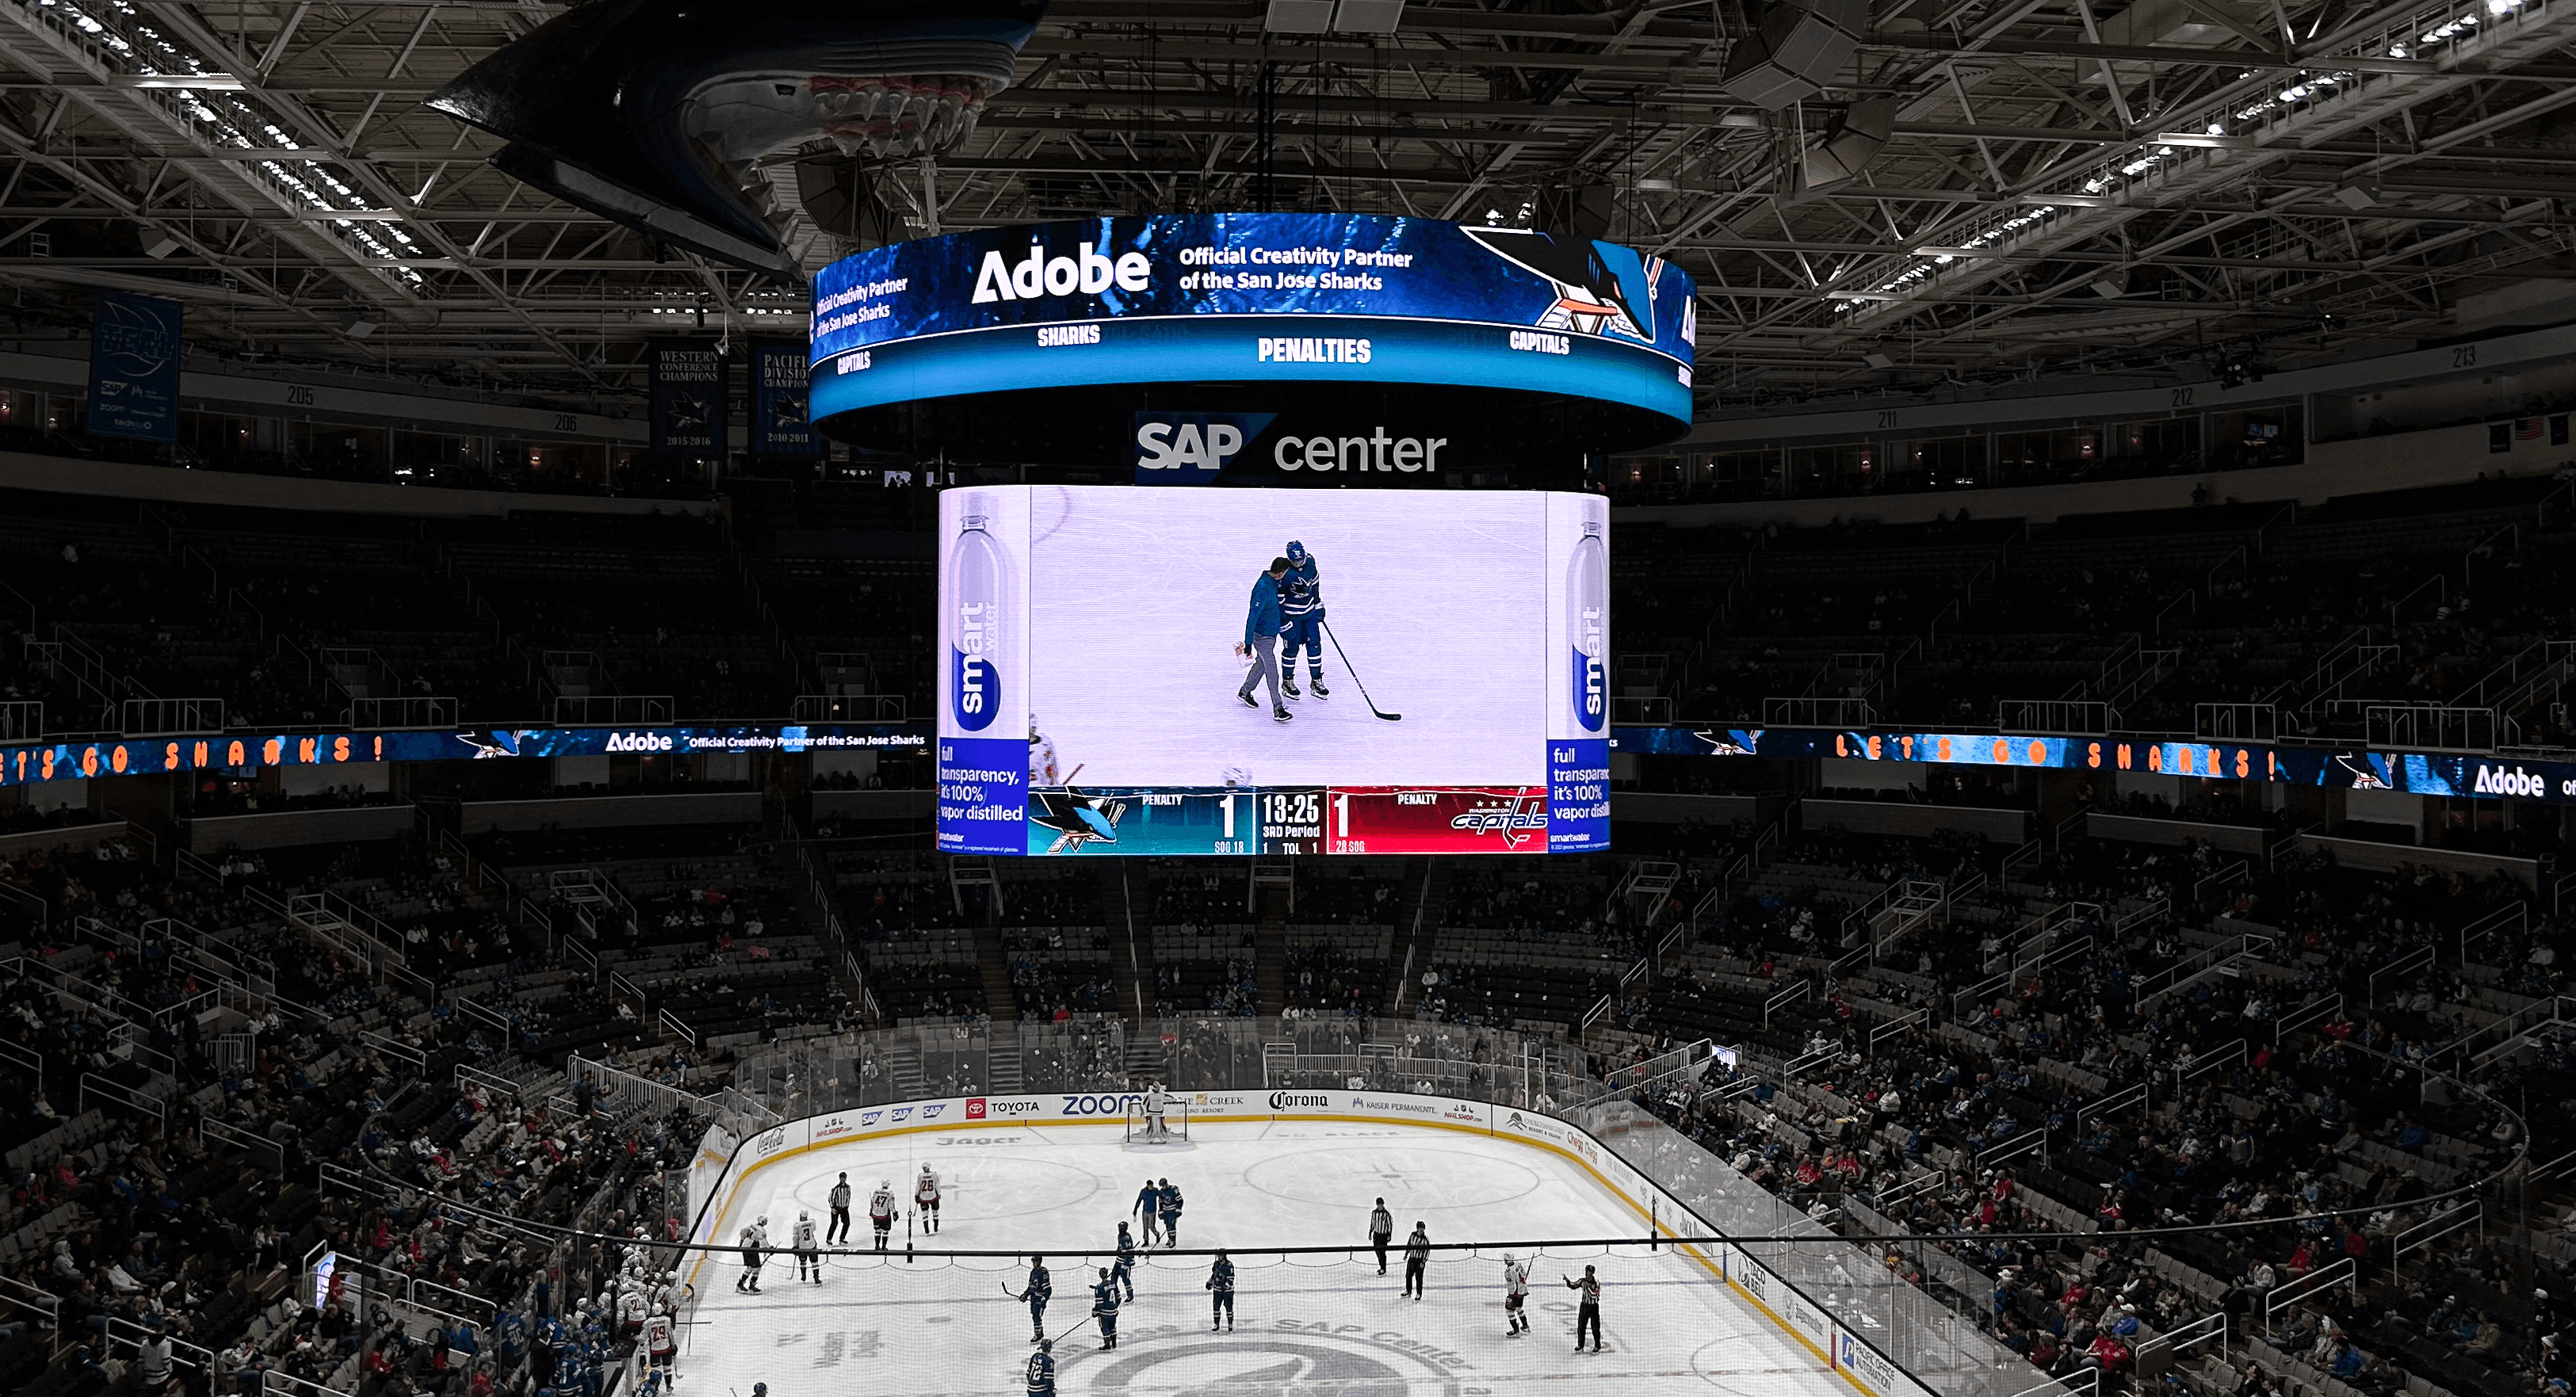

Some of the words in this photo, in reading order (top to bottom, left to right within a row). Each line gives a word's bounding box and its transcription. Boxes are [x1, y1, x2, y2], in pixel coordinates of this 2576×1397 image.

[1179, 247, 1247, 265] Official
[1250, 246, 1341, 268] Creativity
[1344, 249, 1412, 268] Partner
[971, 242, 1151, 305] Adobe
[1179, 271, 1199, 290] of
[1202, 272, 1233, 289] the
[1237, 272, 1273, 289] San
[1275, 272, 1317, 291] Jose
[1320, 272, 1383, 291] Sharks
[833, 284, 868, 307] Creativity
[869, 277, 908, 298] Partner
[829, 317, 841, 333] San
[842, 312, 858, 329] Jose
[858, 302, 890, 323] Sharks
[1038, 325, 1101, 348] SHARKS
[1509, 330, 1570, 355] CAPITALS
[659, 351, 719, 363] WESTERN
[1258, 338, 1372, 364] PENALTIES
[2453, 345, 2476, 368] 213
[659, 362, 719, 372] CONFERENCE
[837, 350, 871, 376] CAPITALS
[659, 372, 719, 382] CHAMPIONS
[287, 385, 314, 406] 205
[2172, 387, 2194, 407] 212
[555, 414, 577, 432] 206
[1878, 410, 1898, 429] 211
[1137, 422, 1243, 470] SAP
[1274, 426, 1447, 473] center
[961, 601, 984, 715] smart
[1582, 606, 1602, 716] smart
[605, 732, 673, 752] Adobe
[689, 737, 726, 748] Official
[728, 735, 775, 749] Creativity
[778, 735, 816, 746] Partner
[816, 736, 829, 746] of
[828, 736, 845, 746] the
[847, 736, 865, 746] San
[867, 736, 889, 746] Jose
[890, 735, 926, 746] Sharks
[1836, 734, 1951, 761] LET'S
[1993, 739, 2047, 765] GO
[82, 746, 128, 777] GO
[941, 746, 954, 761] full
[1554, 747, 1576, 763] full
[941, 766, 1020, 786] transparency,
[2474, 765, 2545, 797] Adobe
[950, 785, 984, 802] 100%
[1142, 794, 1183, 806] PENALTY
[1397, 794, 1438, 806] PENALTY
[1554, 785, 1573, 801] it's
[1573, 784, 1603, 801] 100%
[941, 806, 965, 821] vapor
[966, 804, 1024, 821] distilled
[1219, 794, 1235, 838] 1
[1263, 794, 1320, 823] 13:25
[1334, 793, 1349, 838] 1
[1554, 807, 1590, 823] vapor
[1263, 826, 1283, 838] 3RD
[1285, 825, 1320, 838] Period
[1550, 833, 1591, 843] smartwater
[1214, 841, 1232, 853] SOG
[1263, 842, 1268, 854] 1
[1282, 842, 1301, 855] TOL
[1312, 842, 1317, 854] 1
[1336, 840, 1347, 853] 28
[1348, 841, 1366, 853] SOG
[991, 1101, 1040, 1116] TOYOTA
[1062, 1094, 1143, 1115] zoom
[1210, 1097, 1244, 1105] CREEK
[1268, 1090, 1329, 1113] Corona
[1366, 1101, 1389, 1110] KAISER
[1391, 1103, 1437, 1114] PERMANENTE
[862, 1113, 879, 1125] SAP
[892, 1110, 909, 1121] SAP
[923, 1105, 941, 1117] SAP
[921, 1180, 934, 1192] 26
[874, 1195, 888, 1208] 47
[1749, 1261, 1766, 1285] TACO
[1751, 1277, 1766, 1302] BELL
[651, 1325, 667, 1342] 29
[1274, 1319, 1364, 1334] SAP
[1875, 1358, 1895, 1382] OFFICE
